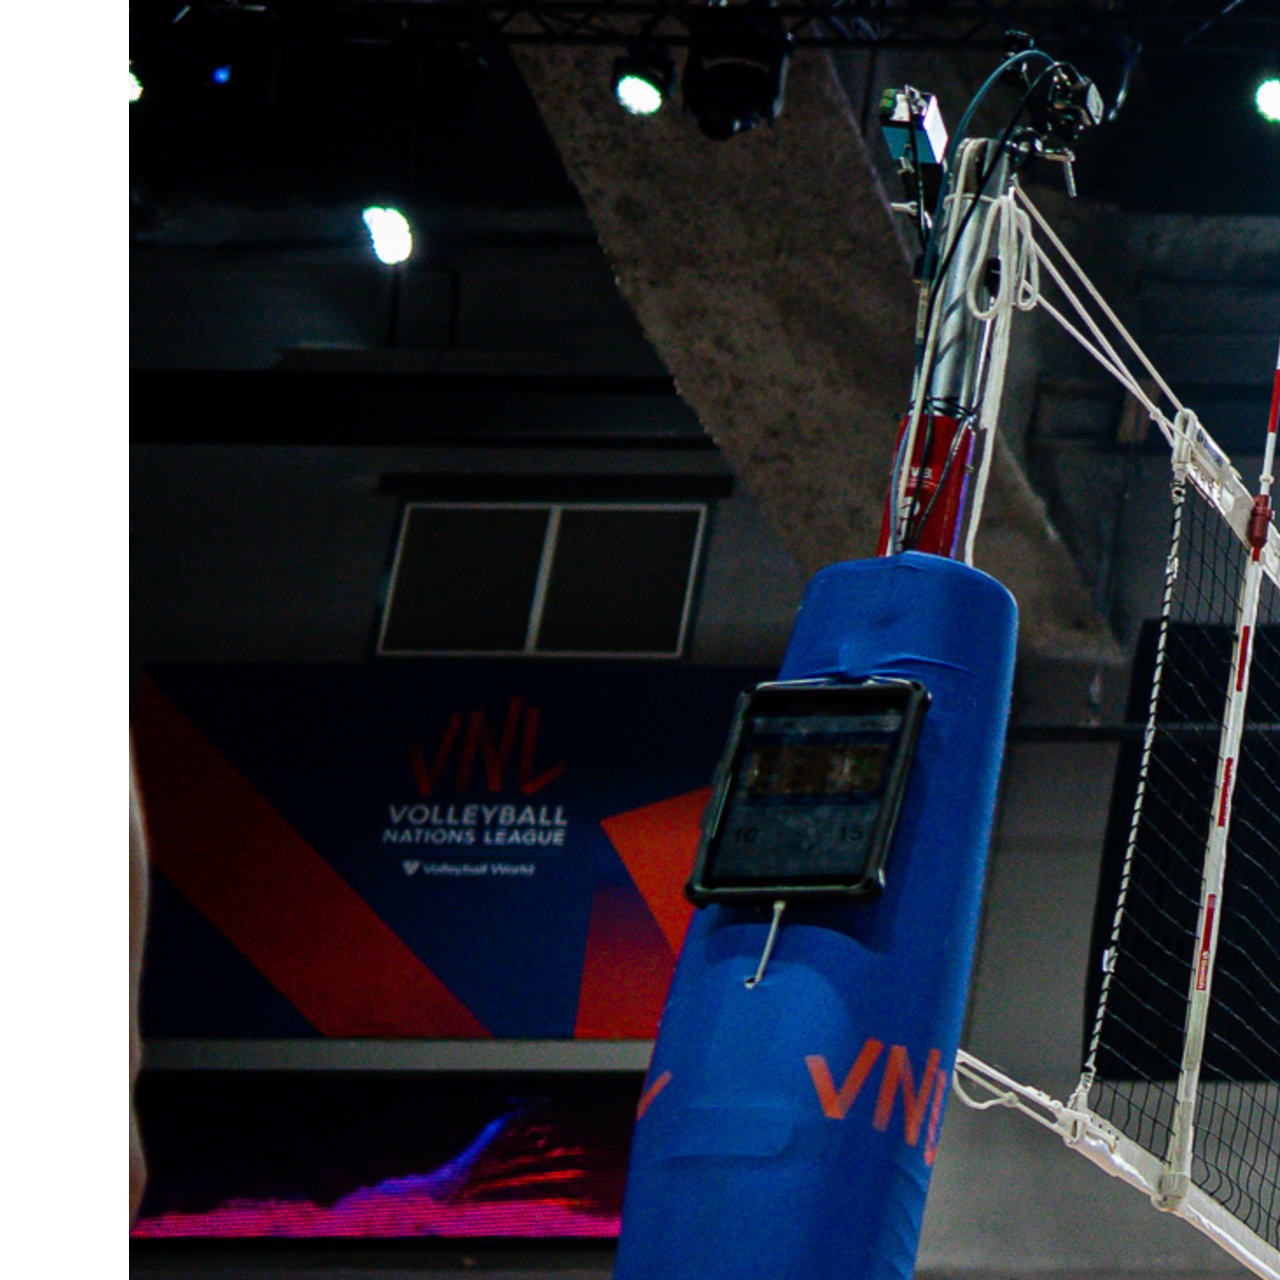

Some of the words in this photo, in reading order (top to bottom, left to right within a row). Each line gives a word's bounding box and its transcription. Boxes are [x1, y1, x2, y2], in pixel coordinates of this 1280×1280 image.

[408, 694, 568, 797] VNL
[388, 804, 569, 827] VOLLEYBALL
[382, 828, 476, 845] NATIONS
[483, 829, 567, 847] LEAGUE
